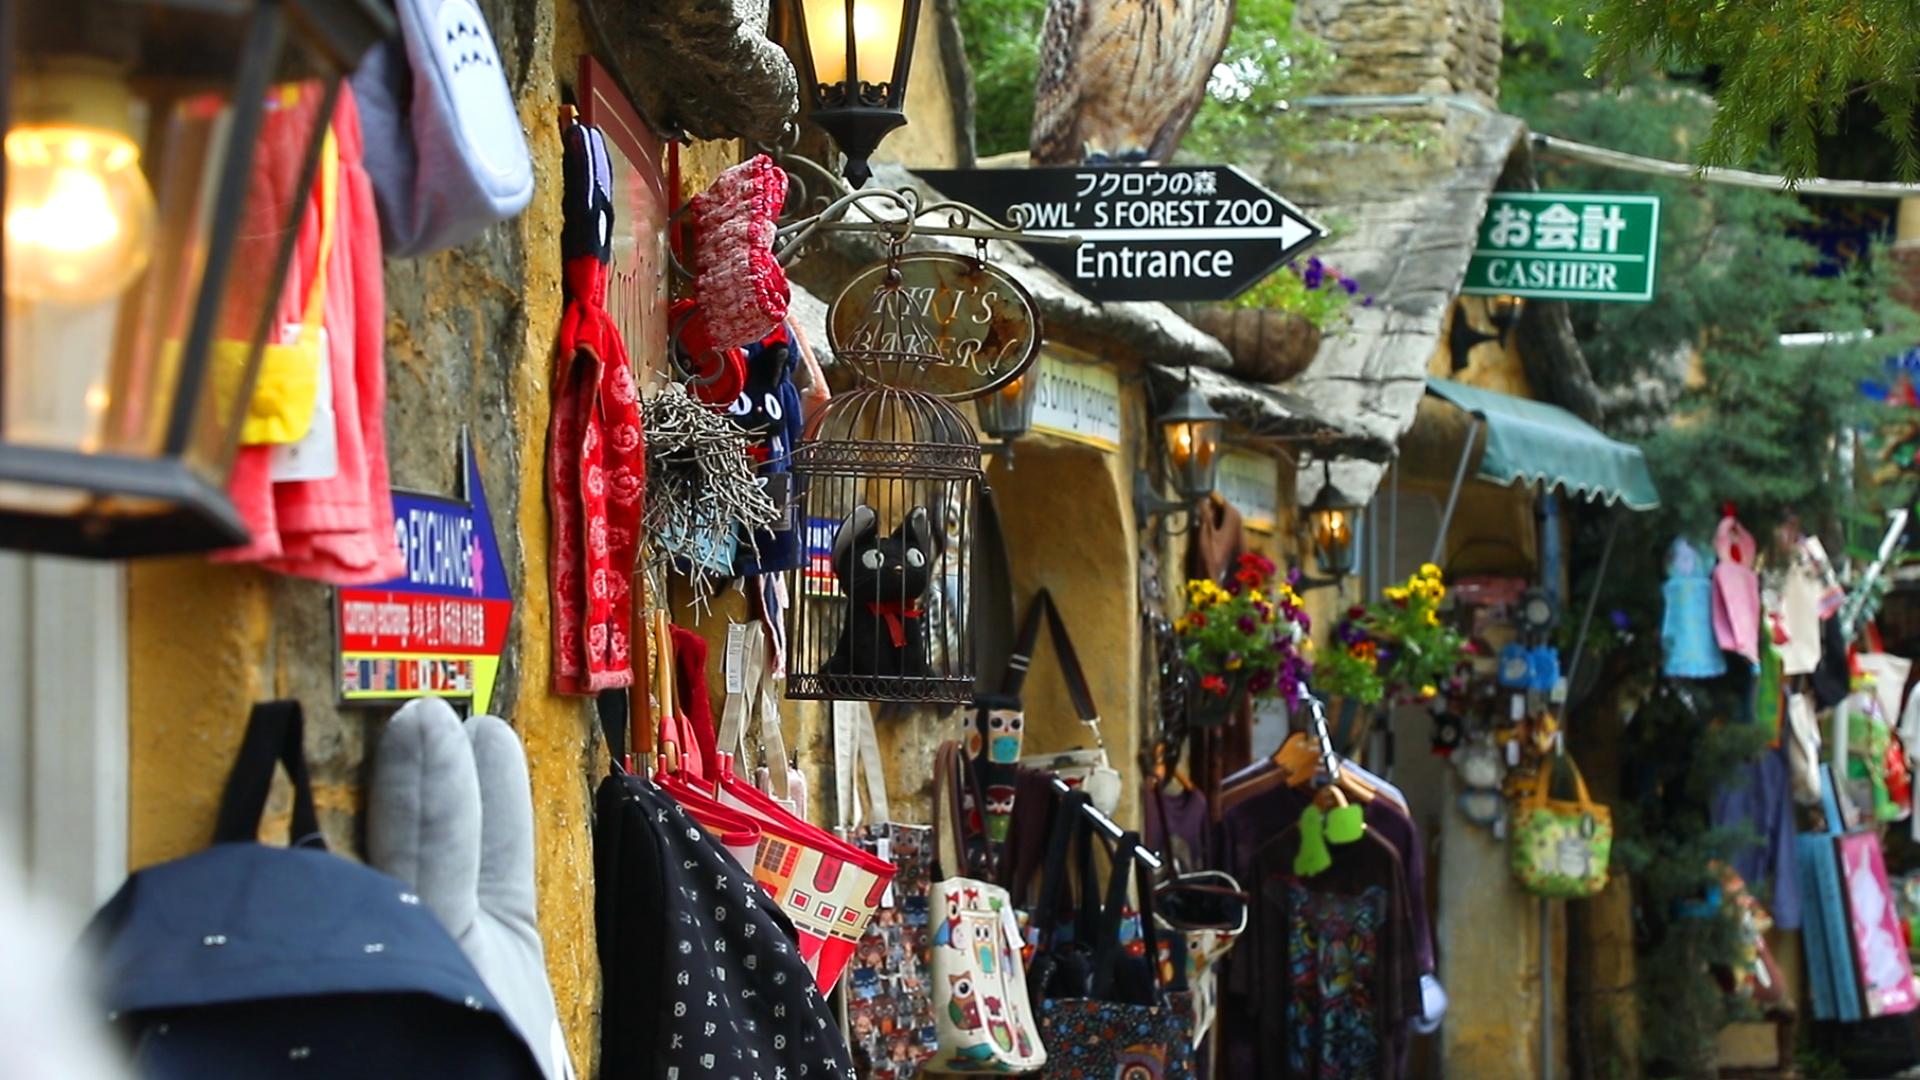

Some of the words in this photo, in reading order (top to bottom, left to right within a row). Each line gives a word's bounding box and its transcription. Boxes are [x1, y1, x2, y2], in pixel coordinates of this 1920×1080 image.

[1076, 171, 1217, 197] フクロウの森
[1115, 201, 1209, 227] FOREST
[1215, 199, 1273, 226] ZOO
[1488, 202, 1627, 252] お会計
[1076, 243, 1234, 278] Entrance
[1486, 259, 1619, 290] CASHIER
[409, 509, 474, 588] EXCHANGE
